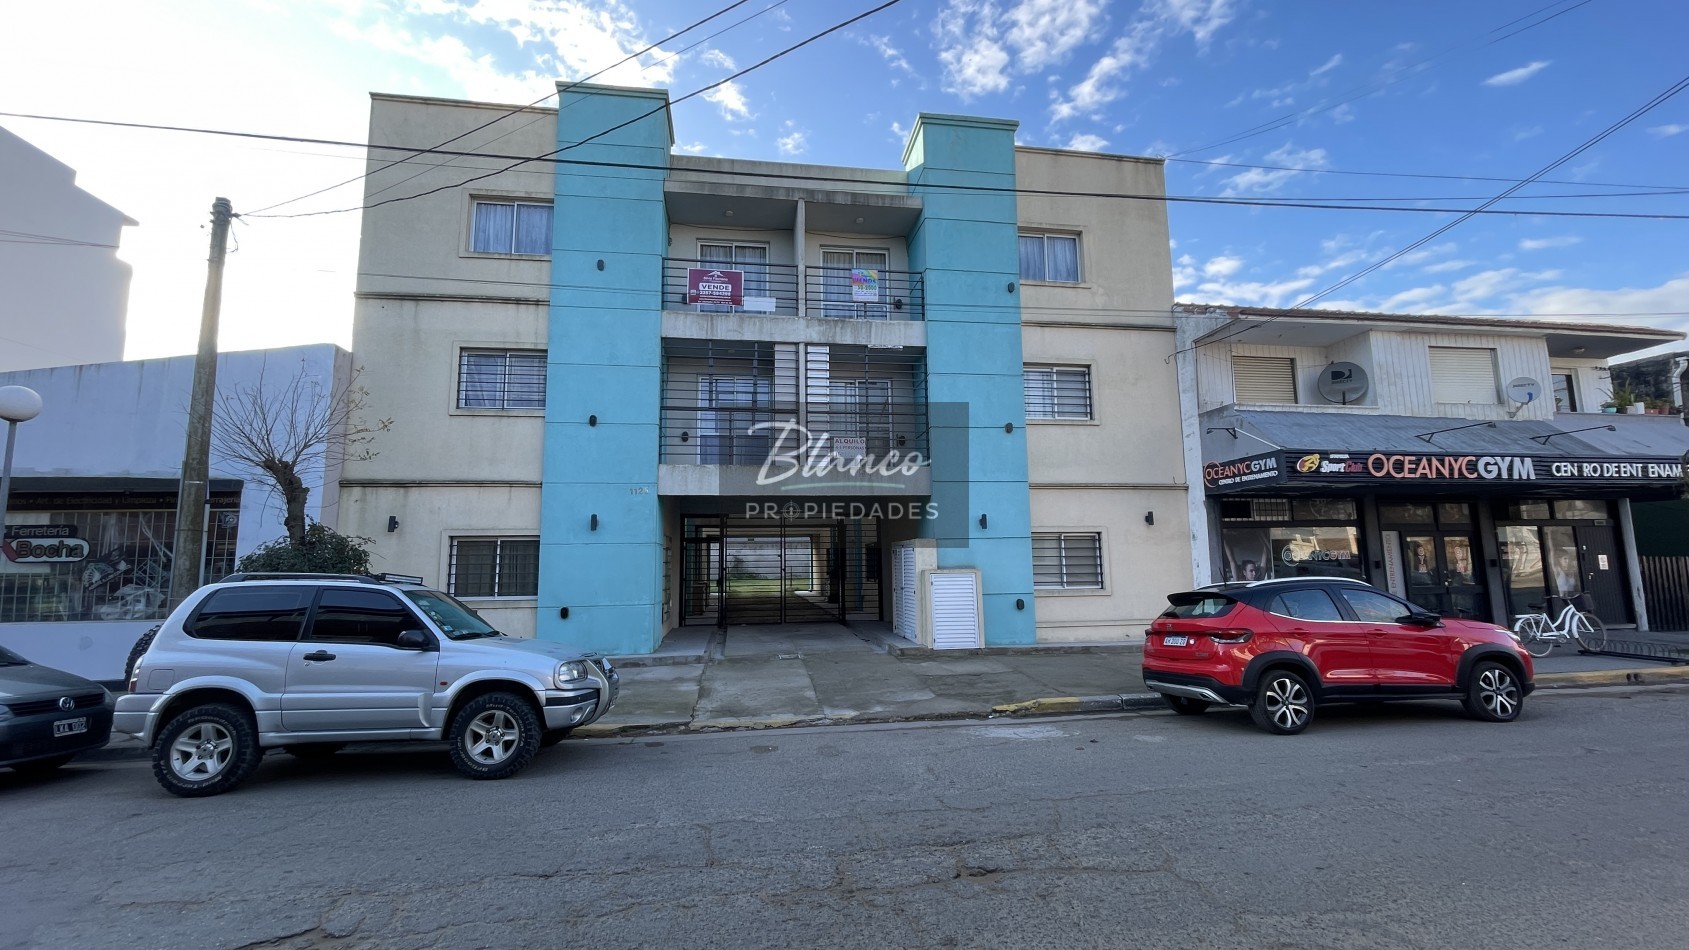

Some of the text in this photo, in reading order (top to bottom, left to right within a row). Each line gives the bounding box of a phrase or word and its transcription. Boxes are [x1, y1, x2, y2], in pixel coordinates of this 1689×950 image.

[1205, 457, 1278, 479] OCEANYCGYM
[1367, 453, 1537, 480] OCEANYCGYM
[16, 539, 85, 559] Bocha
